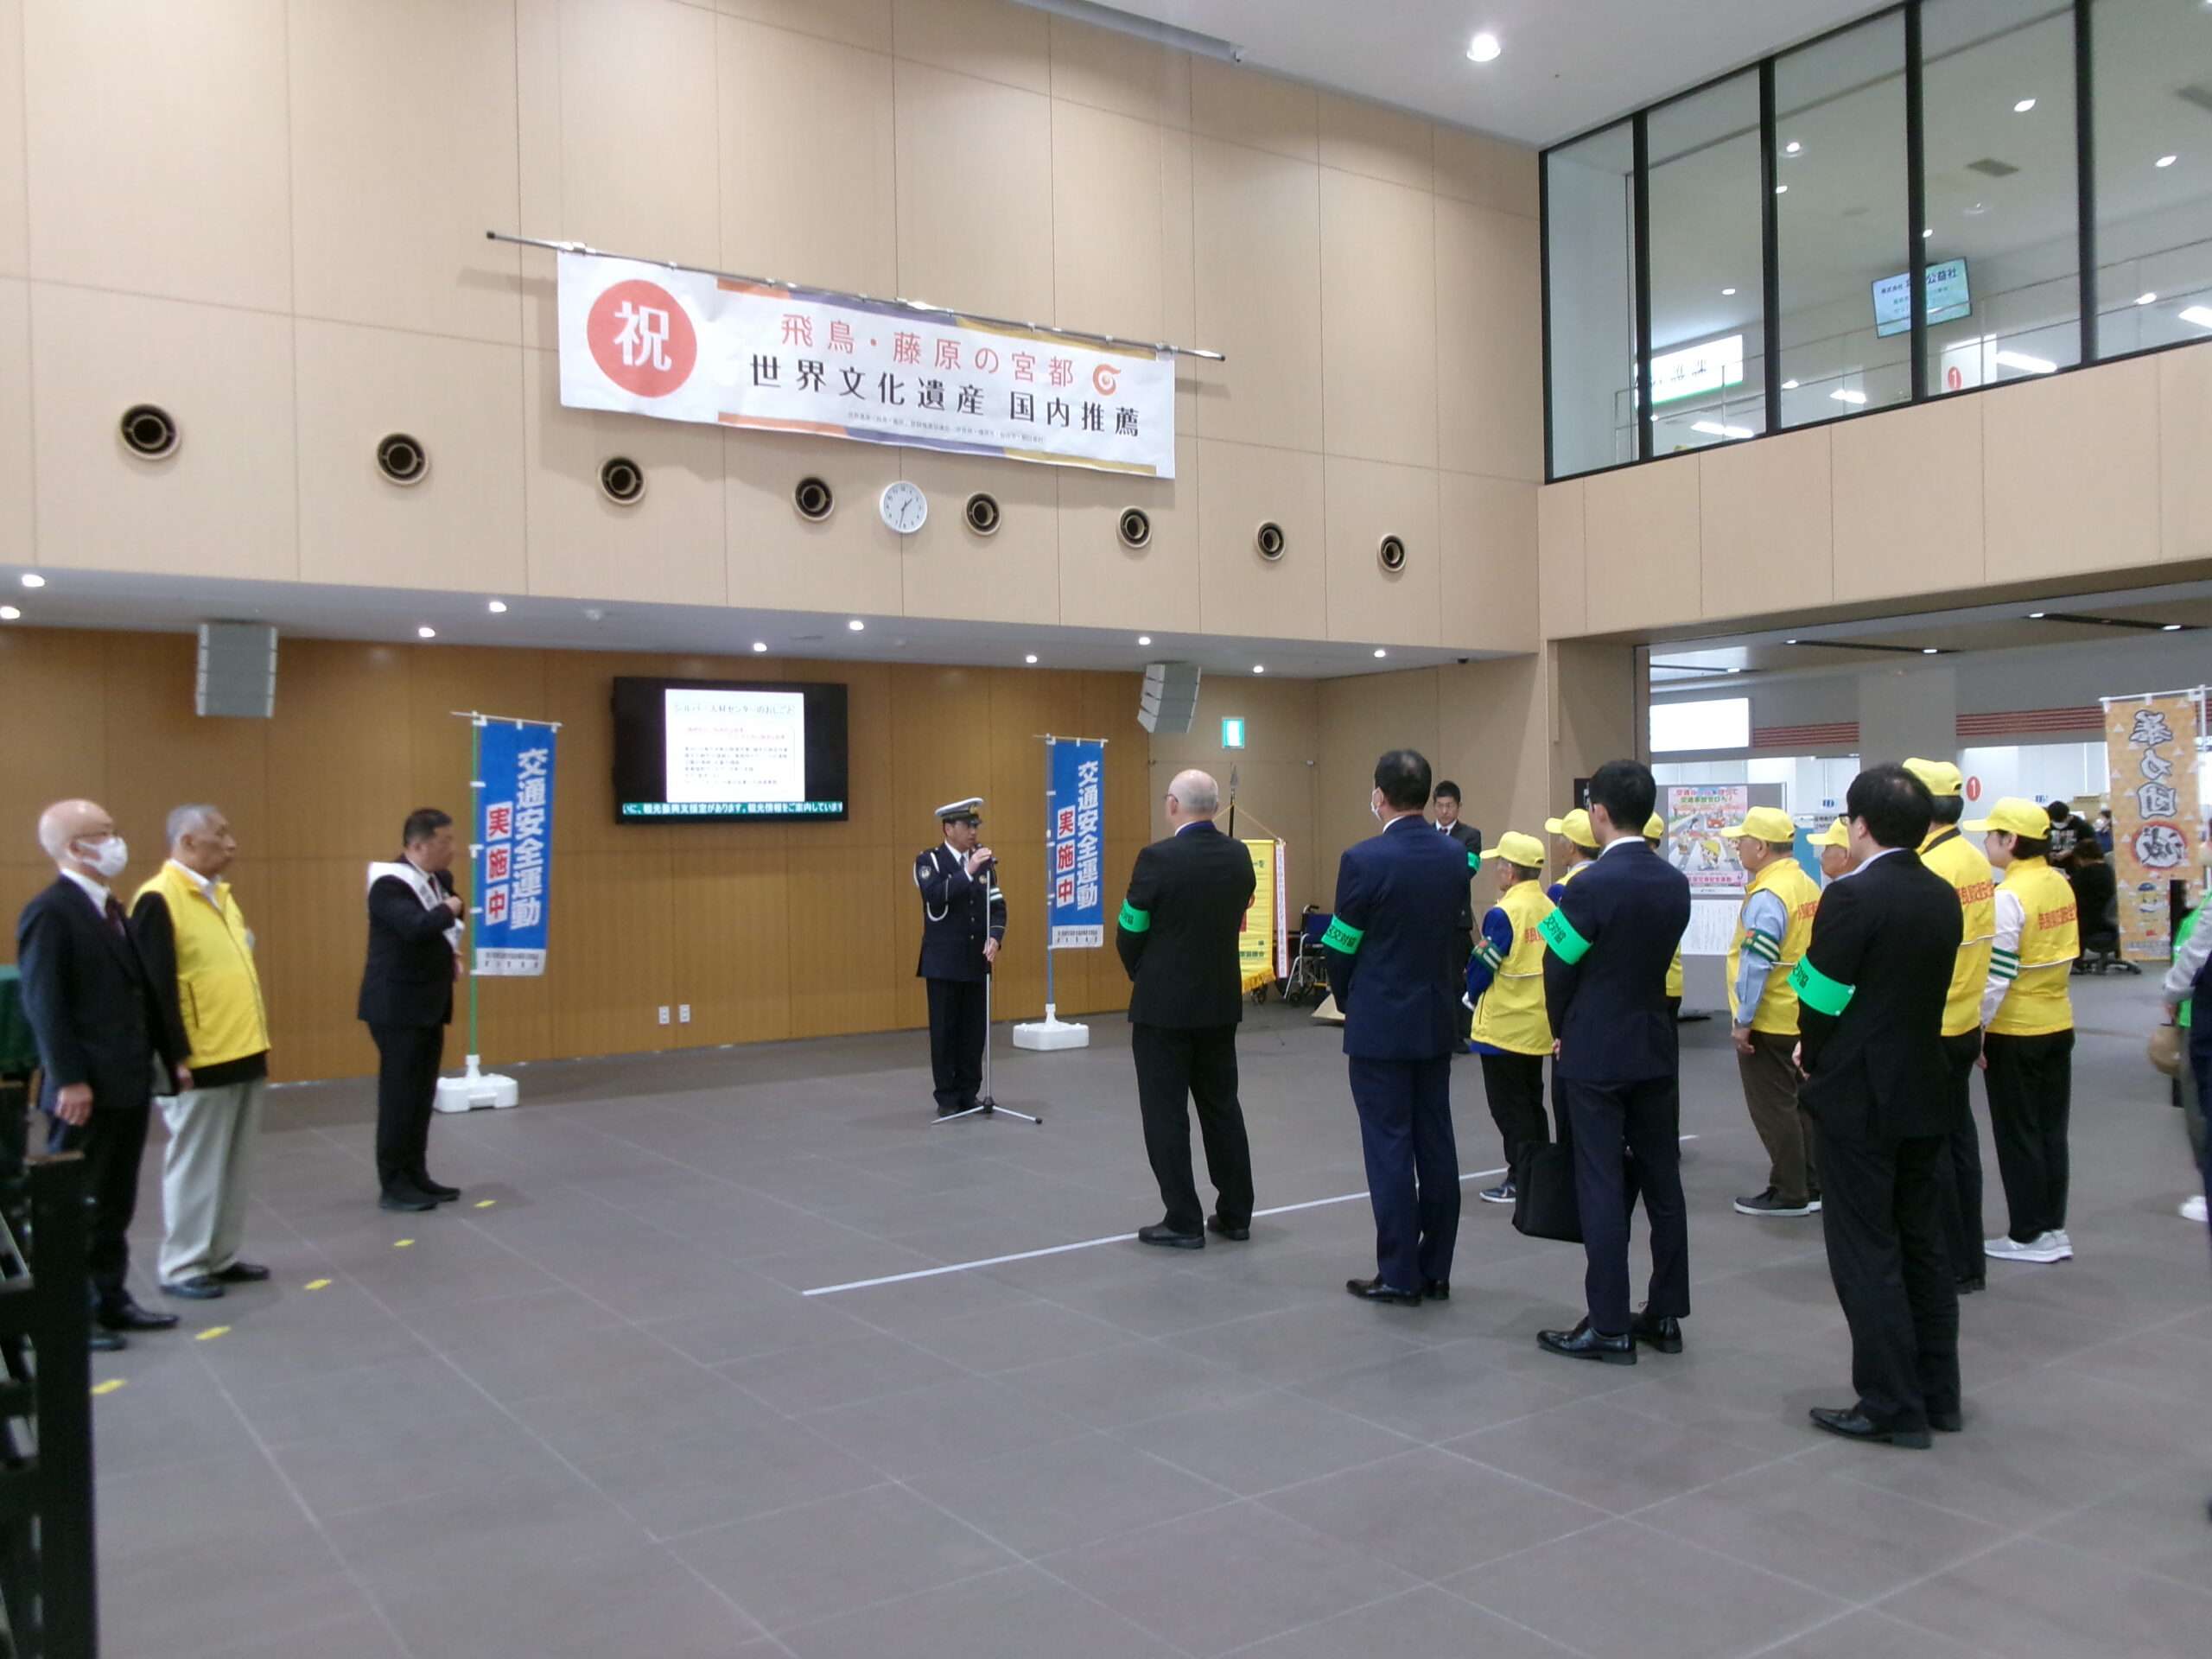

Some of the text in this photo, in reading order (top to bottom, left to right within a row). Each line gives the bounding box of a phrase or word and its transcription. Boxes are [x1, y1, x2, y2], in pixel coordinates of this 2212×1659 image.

[612, 300, 672, 372] 祝
[779, 313, 1075, 388] 飛鳥・藤原の宮都
[750, 353, 985, 416] 世界文化遺産
[1009, 391, 1140, 437] 国内推薦
[486, 806, 511, 920] 実施中
[510, 747, 549, 931] 交通安全運動
[1057, 810, 1074, 904] 実施中
[1077, 760, 1099, 912] 交通安全運動
